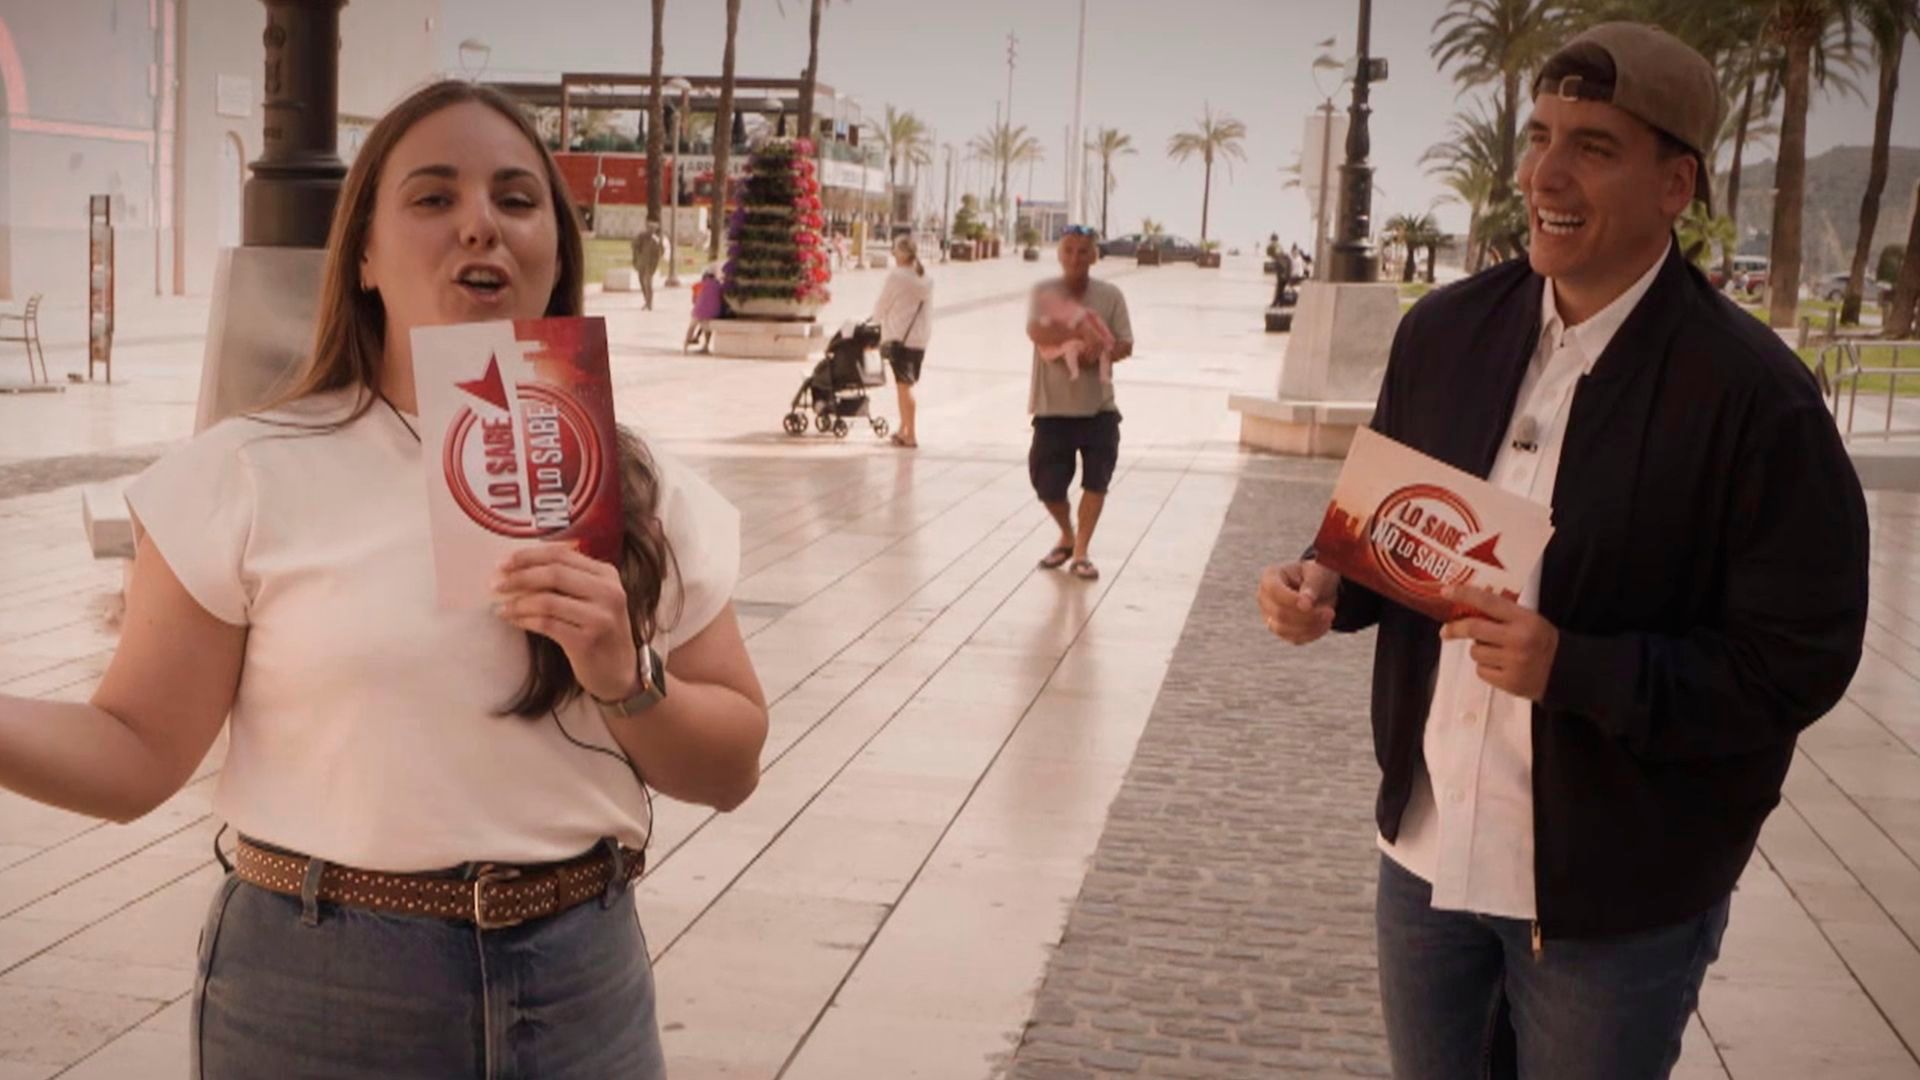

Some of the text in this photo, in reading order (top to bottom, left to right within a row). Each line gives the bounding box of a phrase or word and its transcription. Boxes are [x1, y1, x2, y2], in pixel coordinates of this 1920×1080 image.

[482, 415, 521, 509] LO SABE
[526, 404, 571, 529] NO LO SABE
[1371, 520, 1400, 551] NO
[1396, 537, 1416, 558] LO
[1399, 501, 1467, 554] LO SABE
